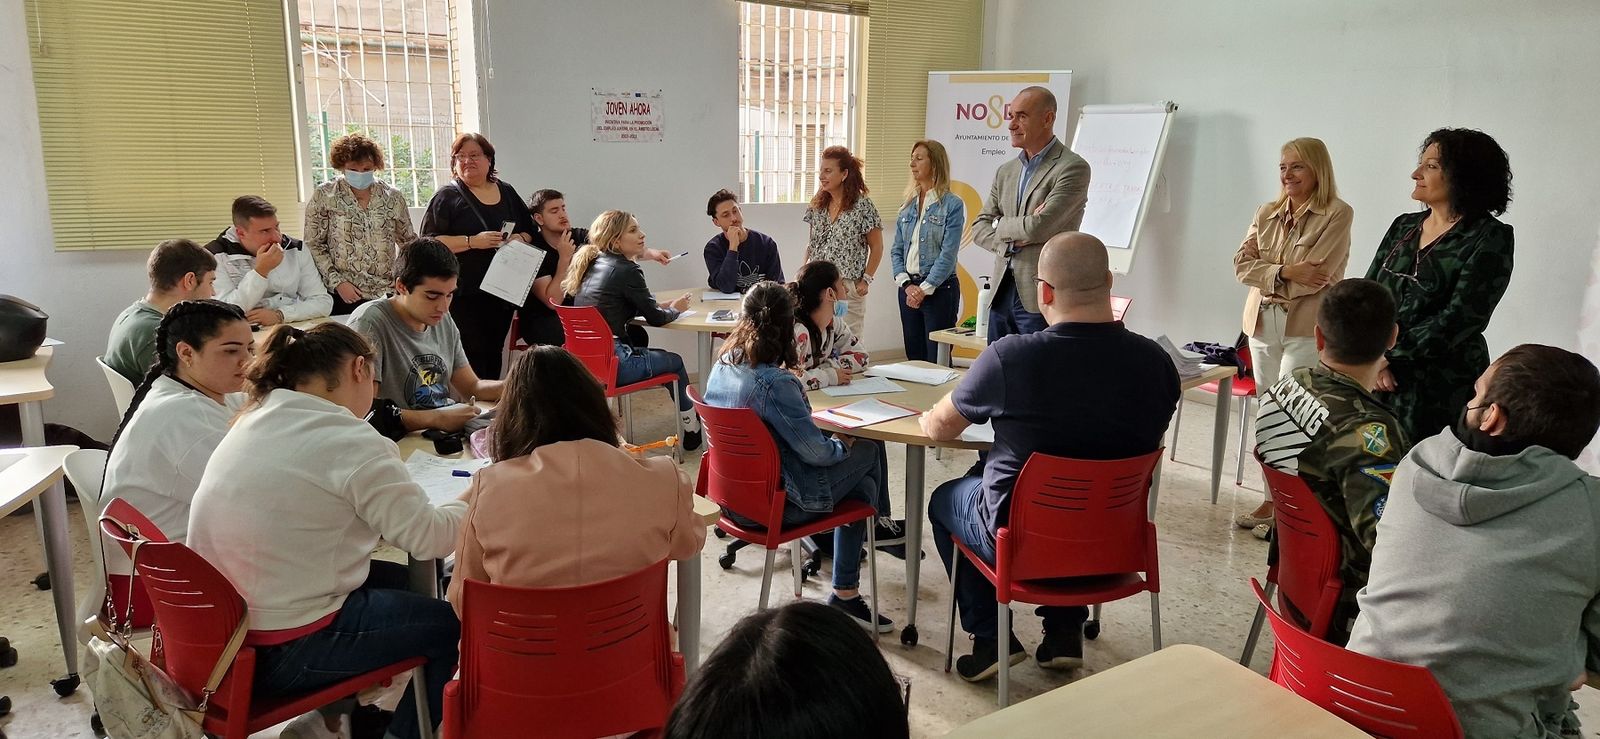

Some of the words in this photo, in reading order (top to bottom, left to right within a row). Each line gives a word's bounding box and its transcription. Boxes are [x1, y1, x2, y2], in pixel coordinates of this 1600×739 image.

[606, 101, 628, 115] JOVEN
[630, 102, 651, 115] AHORA
[981, 148, 1006, 156] Empleo
